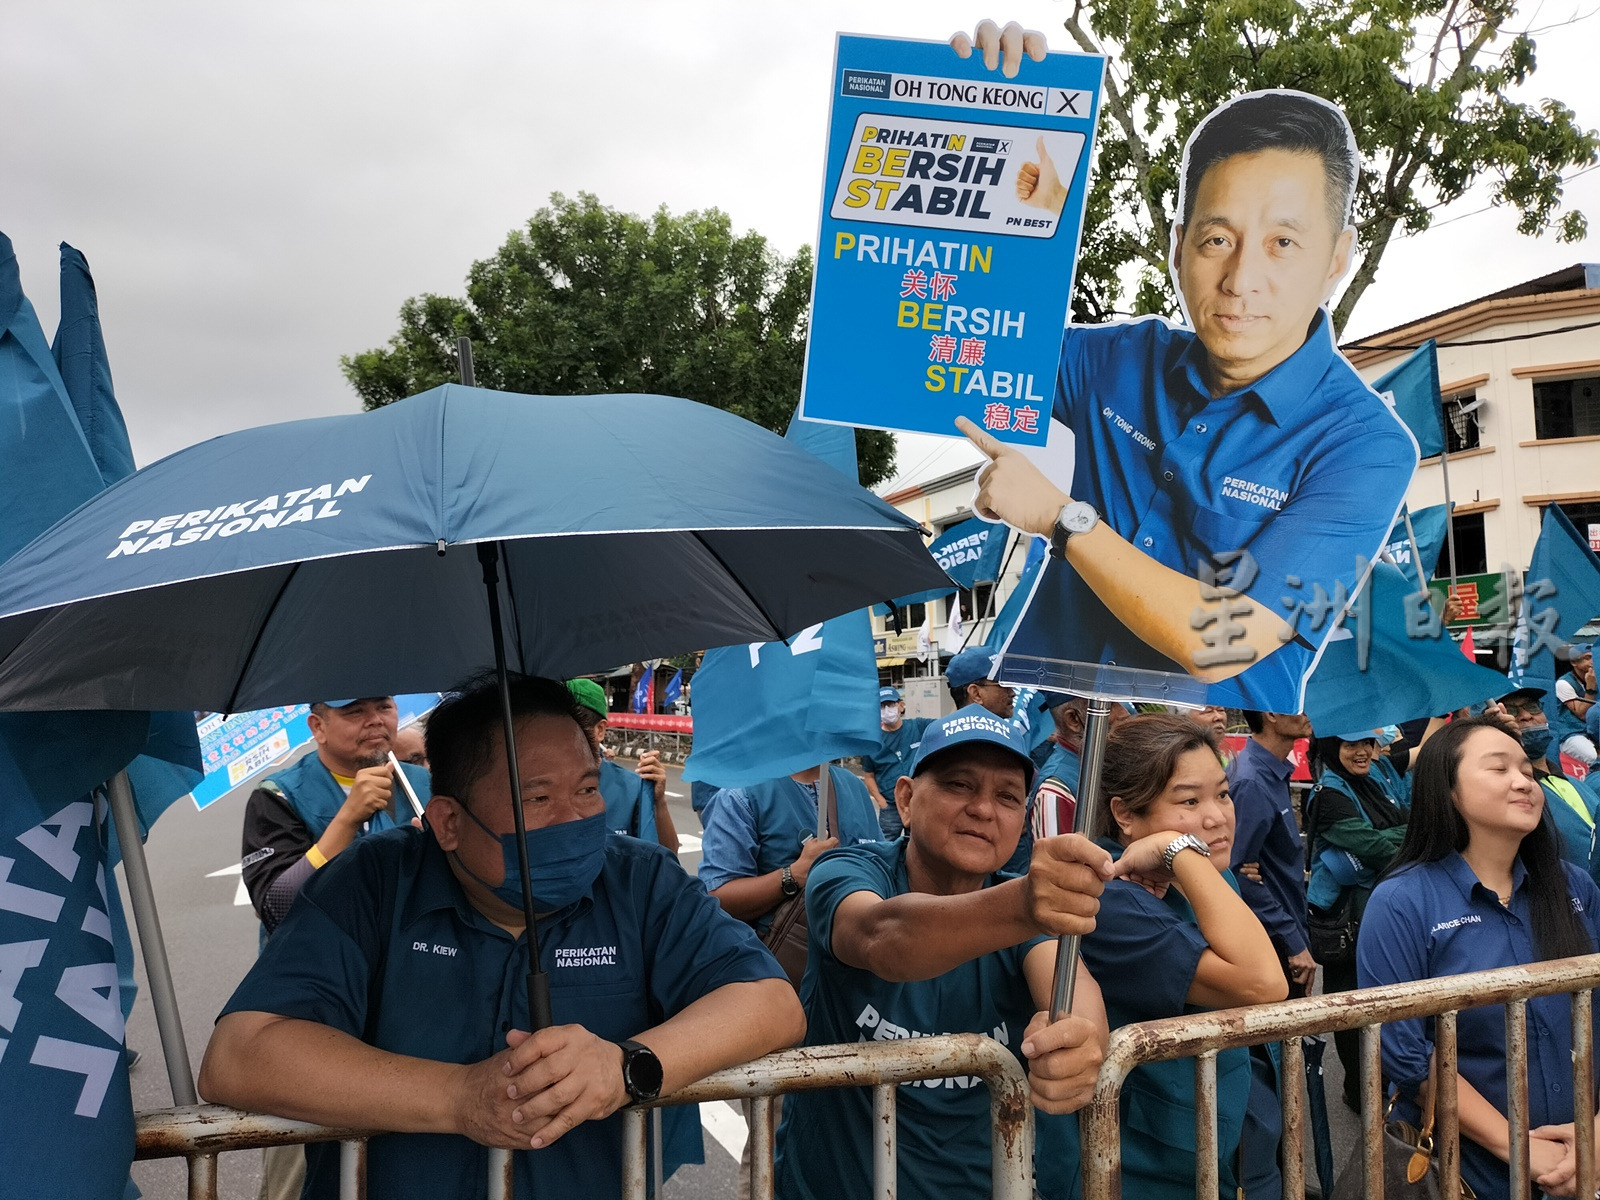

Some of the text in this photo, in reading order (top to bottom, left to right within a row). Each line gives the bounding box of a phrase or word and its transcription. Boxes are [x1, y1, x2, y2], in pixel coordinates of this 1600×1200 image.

[848, 76, 886, 86] PERIKATAN
[849, 83, 884, 93] NASIONAL
[894, 79, 1080, 115] OH TONG KEONG X
[861, 126, 967, 152] PRIHATIN
[852, 145, 1006, 186] BERSIH
[843, 178, 993, 220] STABIL
[1005, 217, 1052, 229] PN BEST
[834, 231, 993, 273] PRIHATIN
[899, 269, 959, 301] 关怀
[897, 300, 1025, 339] BERSIH
[928, 334, 987, 366] 清廉
[924, 364, 1044, 402] STABIL
[983, 402, 1040, 434] 稳定
[1102, 407, 1157, 451] OH TONG KEONG
[1221, 486, 1282, 511] NASIONAL
[1222, 476, 1289, 502] PERIKATAN
[118, 474, 373, 539] PERIKATAN
[106, 500, 343, 559] NASIONAL
[942, 715, 1010, 734] PERIKATAN
[945, 722, 1010, 739] NASIONAL
[1461, 915, 1482, 925] CHAN
[412, 941, 457, 957] DR. KIEW
[555, 946, 617, 958] PERIKATAN
[556, 956, 616, 968] NASIONAL
